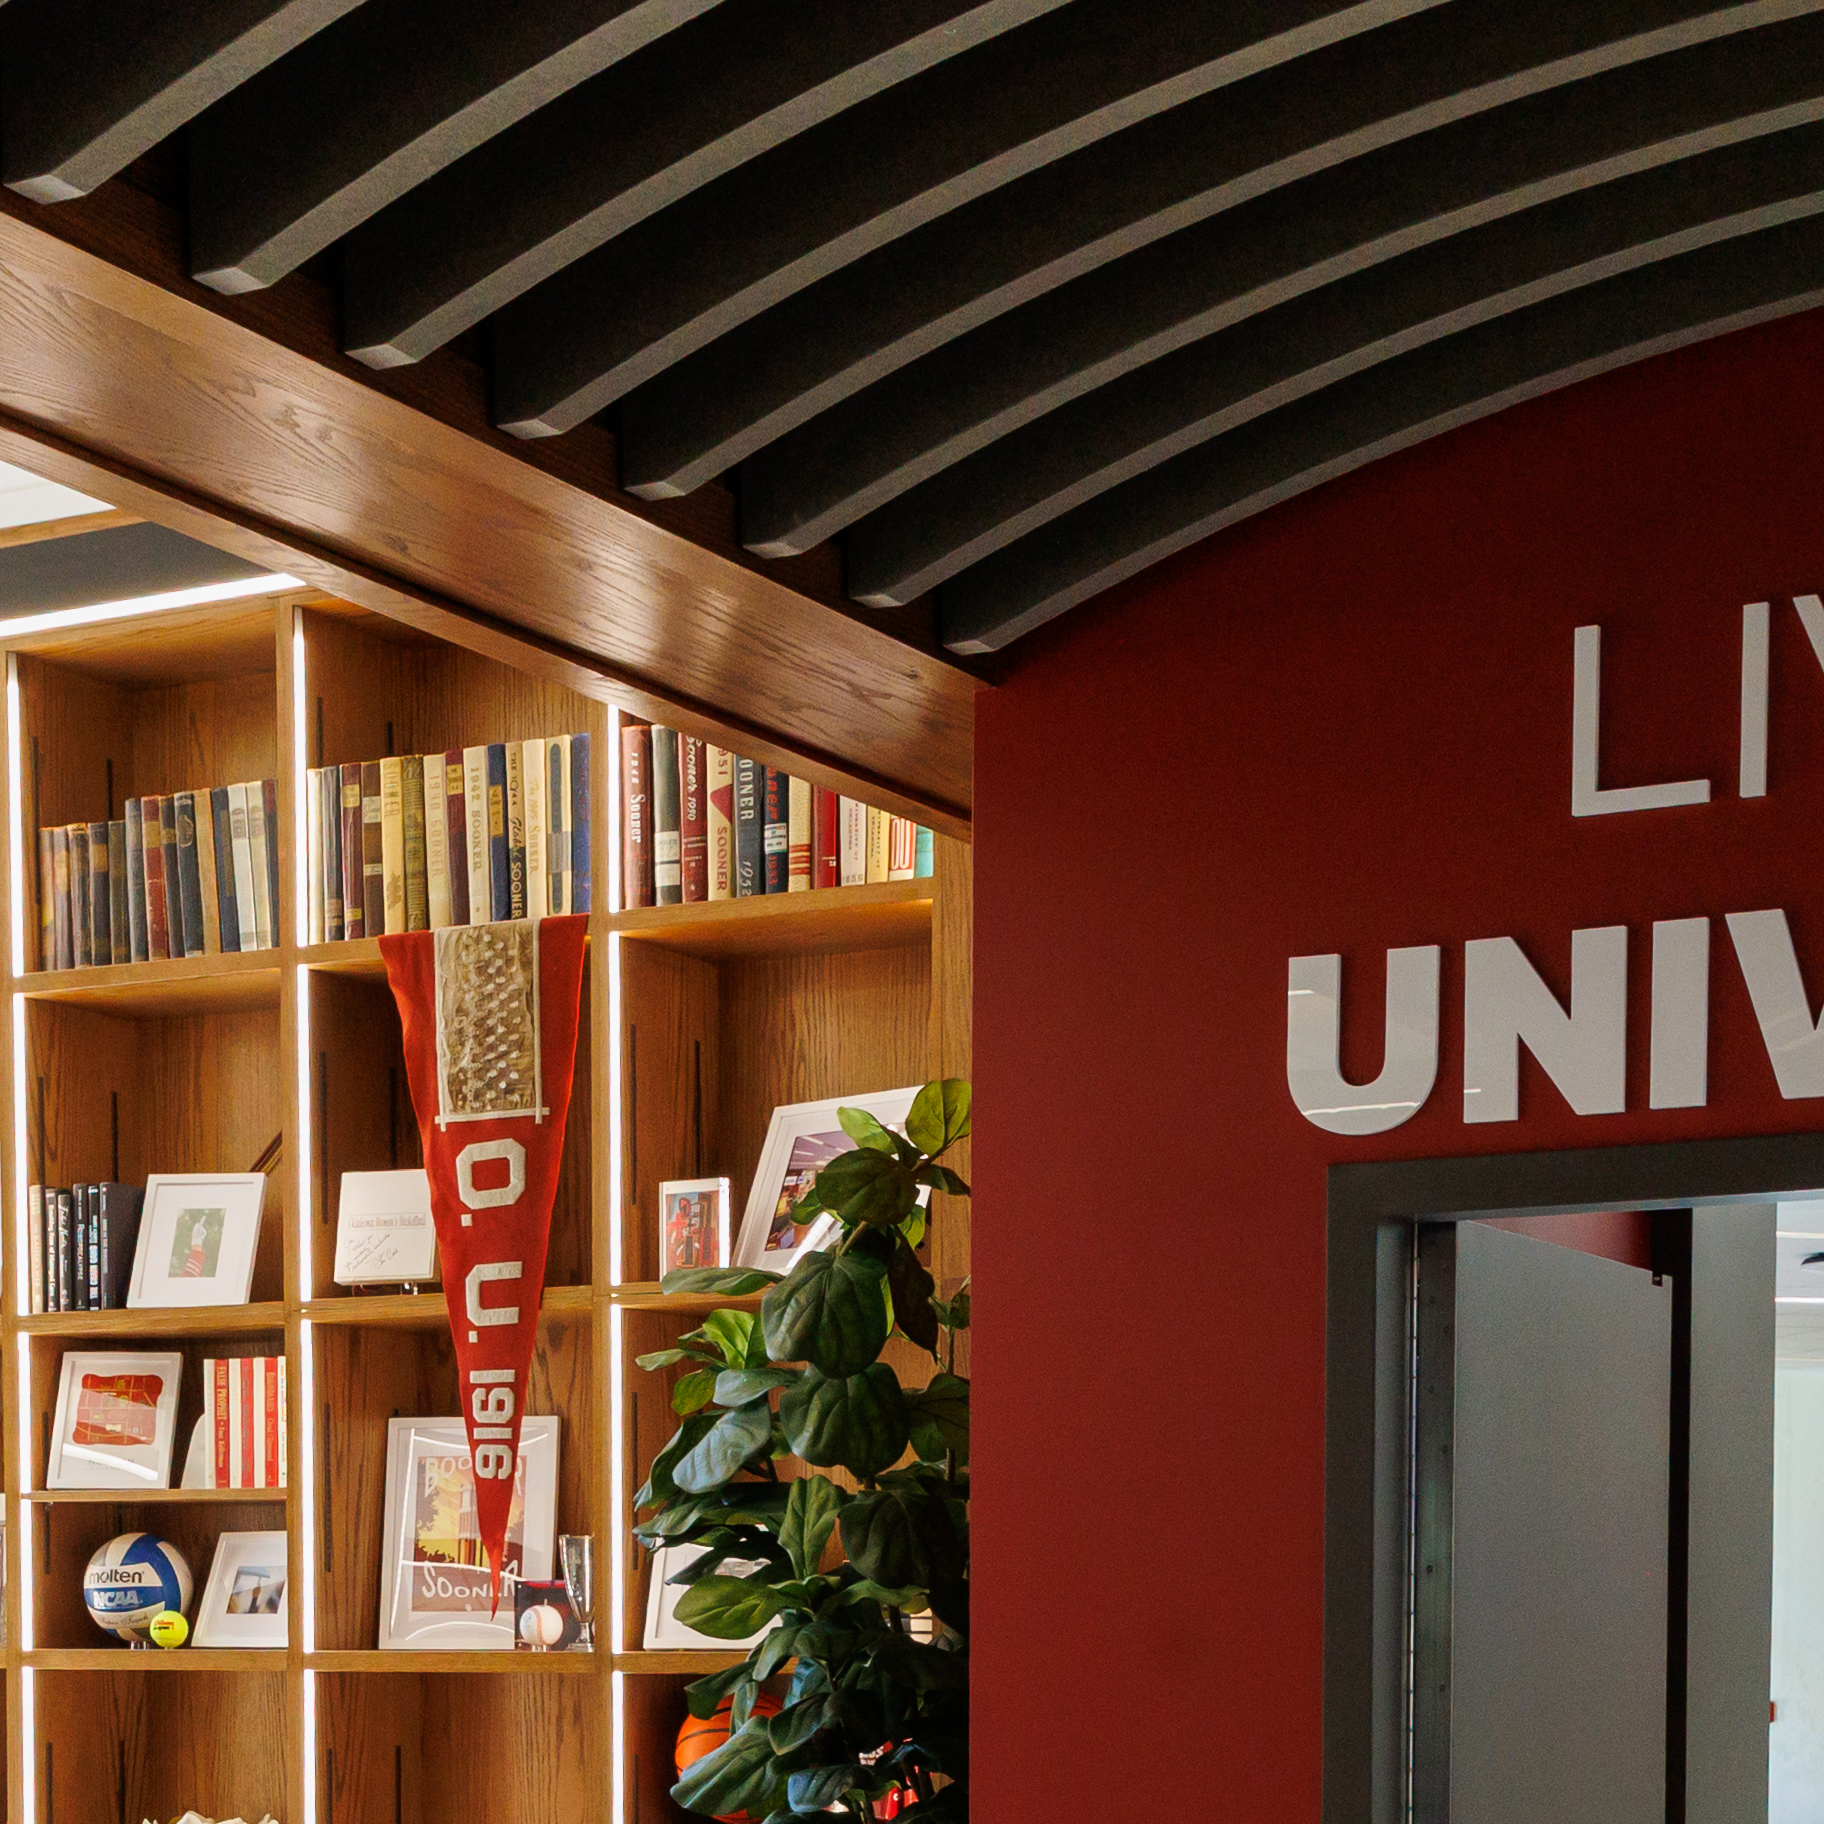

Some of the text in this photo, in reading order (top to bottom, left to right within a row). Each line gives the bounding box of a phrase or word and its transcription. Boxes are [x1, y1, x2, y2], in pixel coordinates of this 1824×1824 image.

[630, 793, 646, 843] Sooner
[738, 757, 755, 820] OONER
[470, 766, 483, 872] 1942 SOONER
[716, 749, 728, 892] 951 SOONER
[510, 861, 523, 919] SOONER
[469, 1367, 516, 1481] 1916
[89, 1569, 142, 1585] molten
[93, 1590, 139, 1609] NCAA
